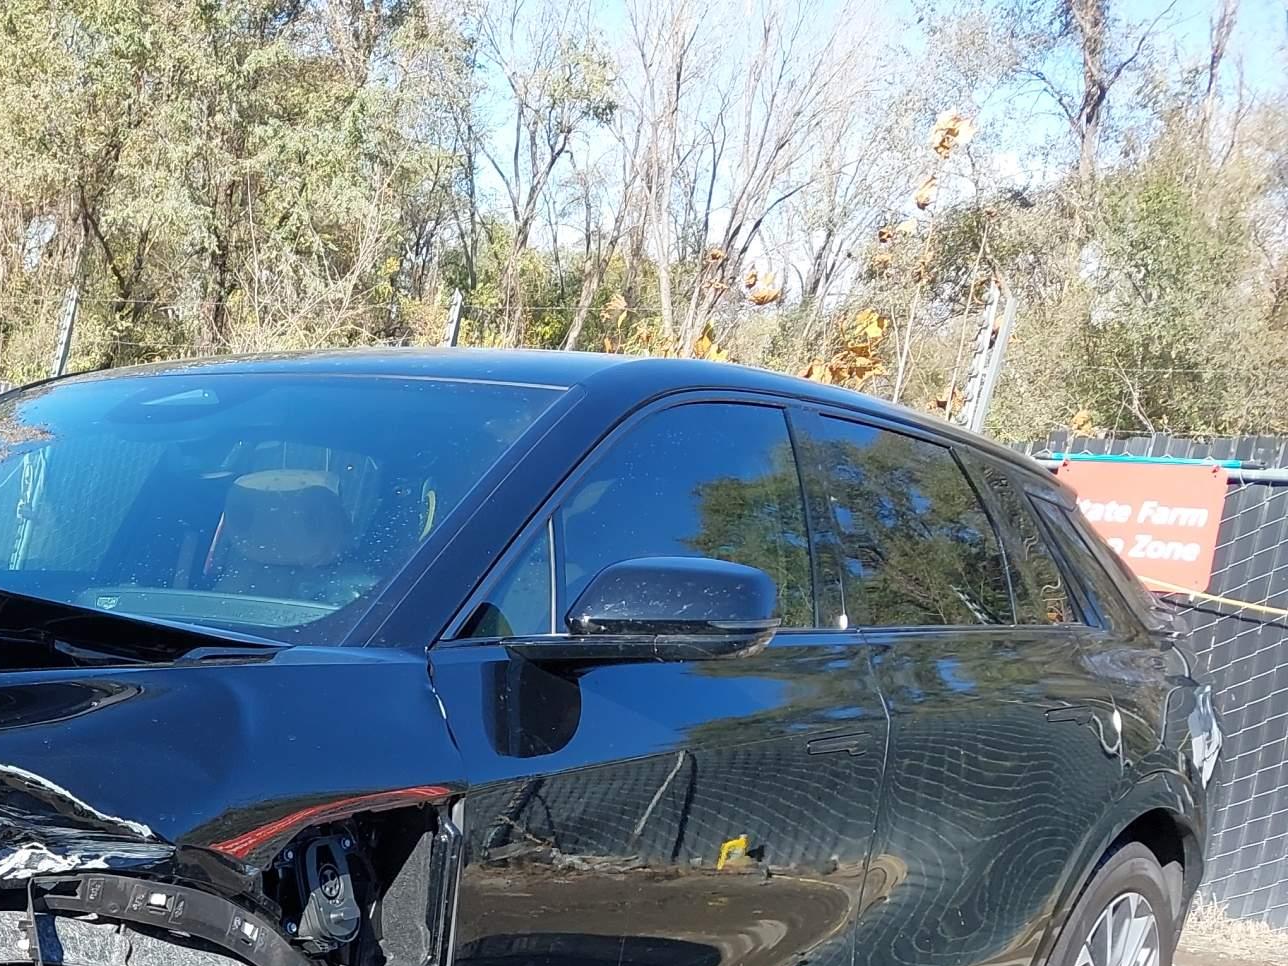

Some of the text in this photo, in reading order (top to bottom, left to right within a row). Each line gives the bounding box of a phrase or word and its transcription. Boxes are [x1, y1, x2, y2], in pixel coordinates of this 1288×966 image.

[1076, 496, 1209, 527] tate Farm
[1128, 534, 1200, 561] Zone
